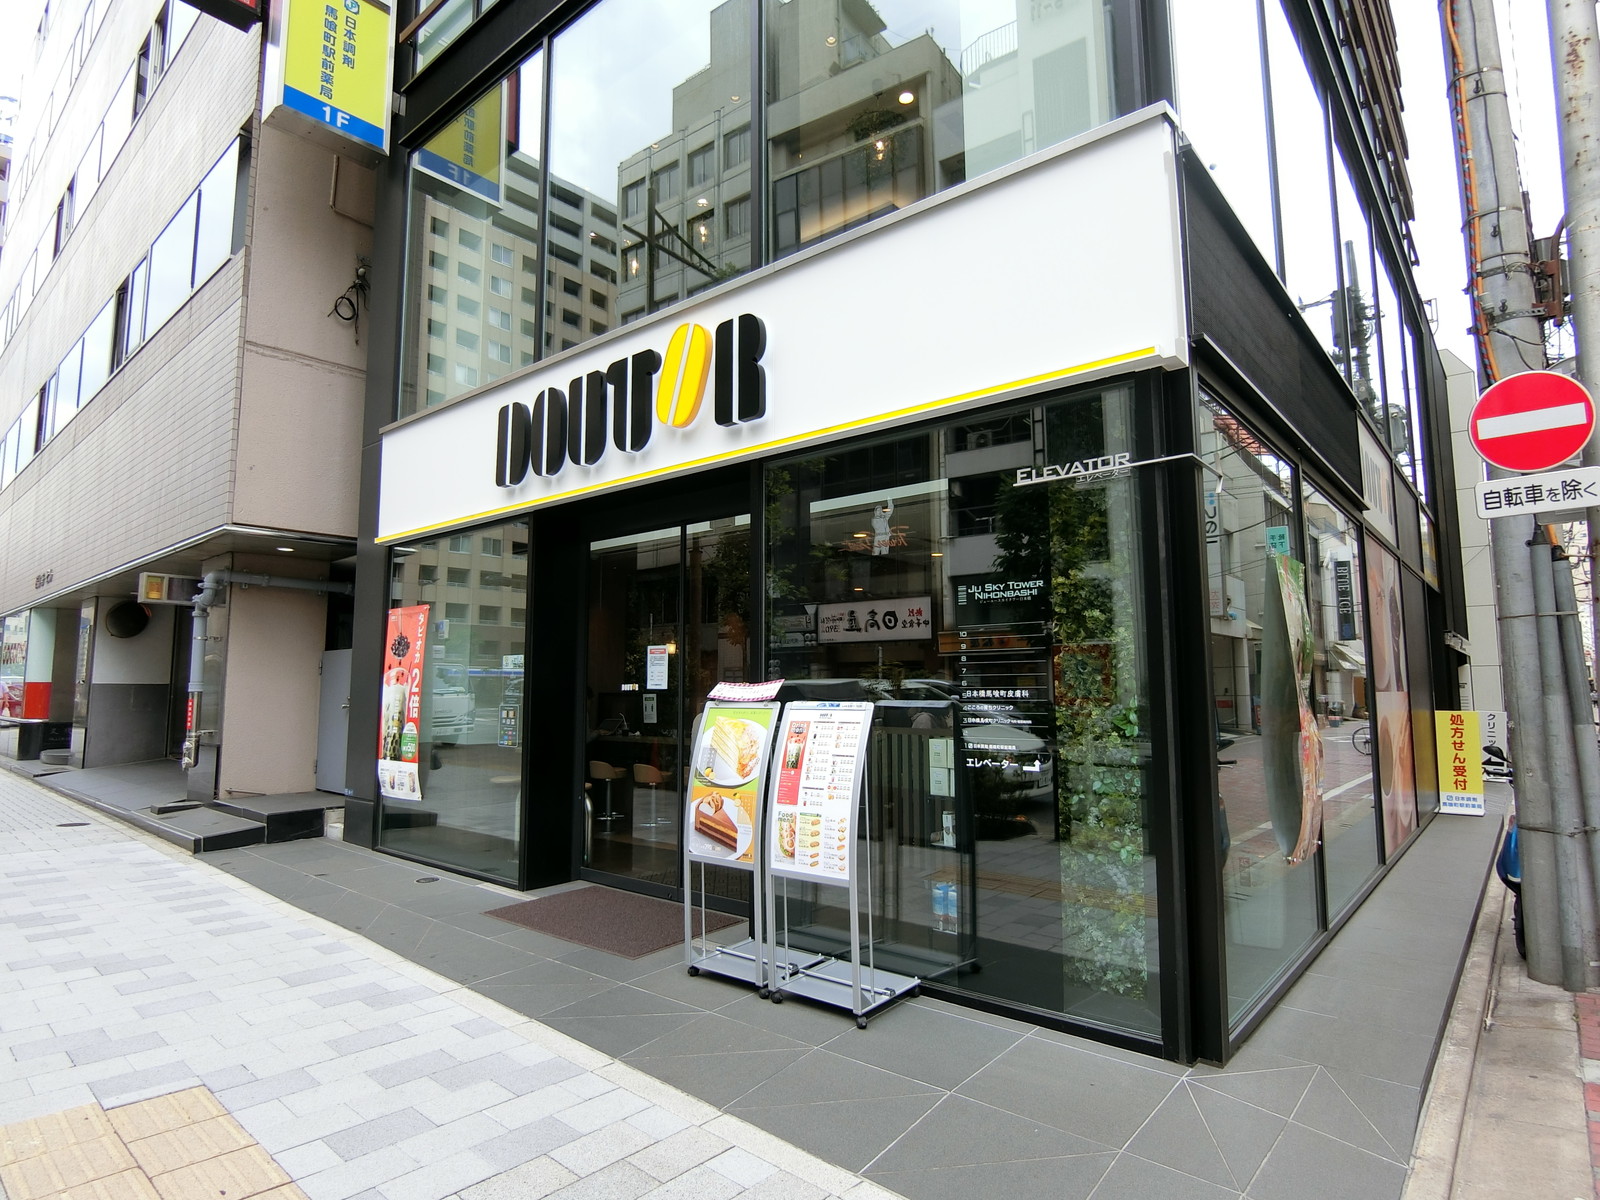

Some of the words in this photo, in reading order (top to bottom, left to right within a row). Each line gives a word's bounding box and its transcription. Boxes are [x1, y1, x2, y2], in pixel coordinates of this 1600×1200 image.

[320, 5, 338, 100] 馬喰町駅前薬局
[342, 16, 357, 69] 日本調剤
[322, 105, 350, 127] 1F
[496, 313, 767, 487] DOUTOR
[1016, 452, 1131, 484] ELEVATOR
[1076, 467, 1131, 484] エレベーター
[1483, 478, 1598, 510] 自転車を除く
[975, 588, 1038, 600] NIHONBASHI
[985, 583, 1005, 592] SKY
[1007, 580, 1044, 590] TOWER
[1487, 713, 1497, 747] クリニッ
[966, 757, 1019, 769] エレベーター
[1450, 714, 1468, 791] 処方せん受付
